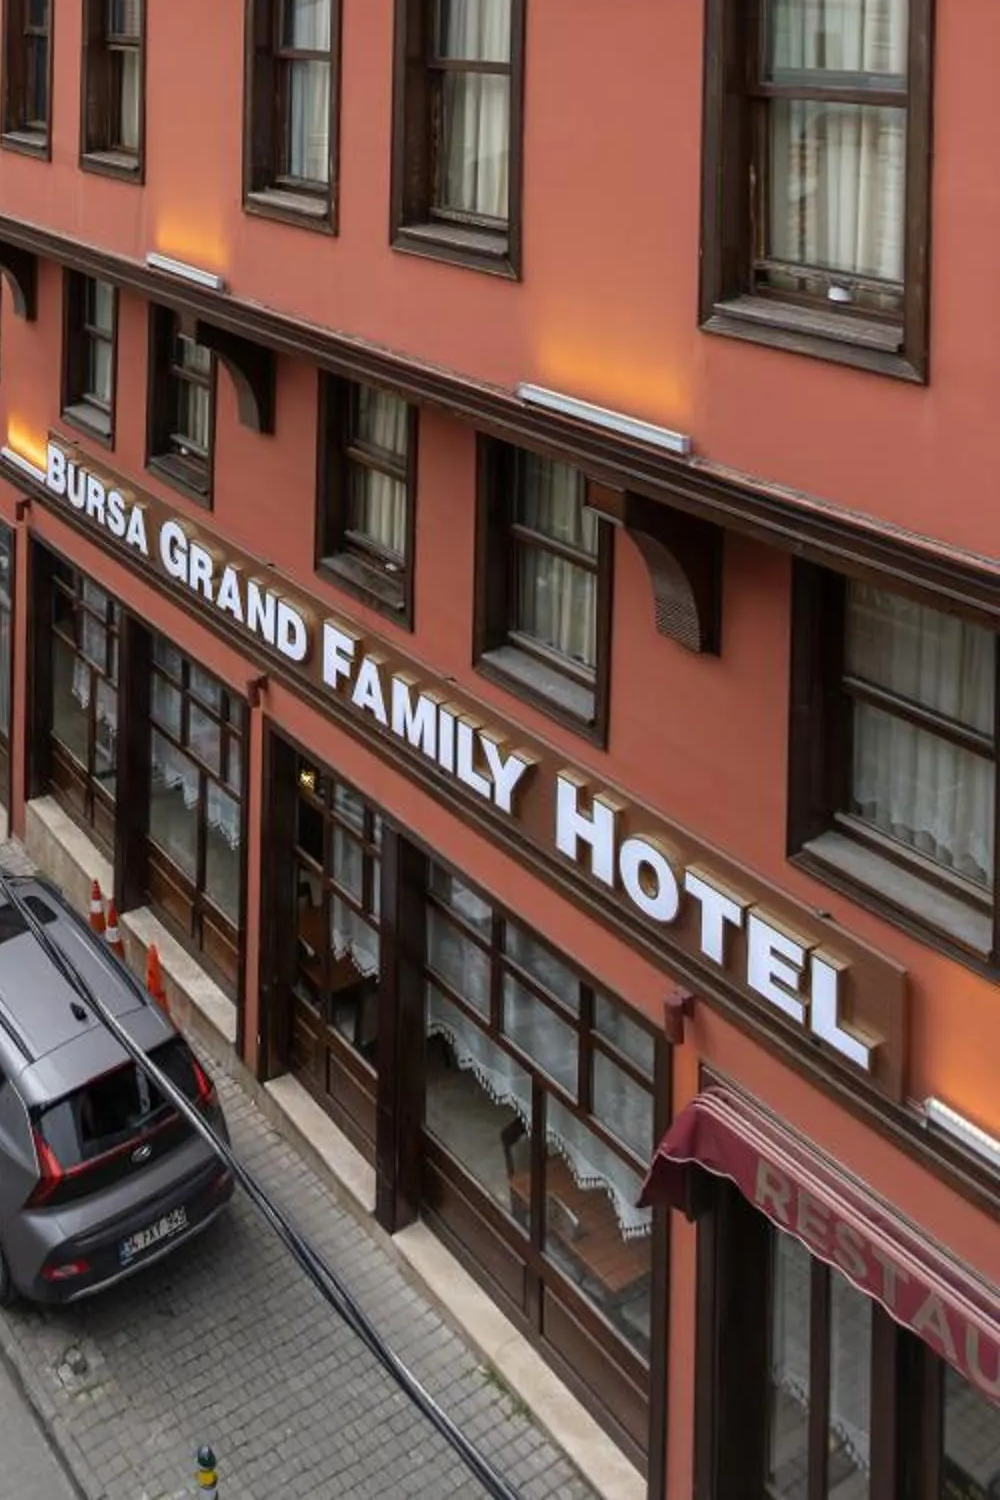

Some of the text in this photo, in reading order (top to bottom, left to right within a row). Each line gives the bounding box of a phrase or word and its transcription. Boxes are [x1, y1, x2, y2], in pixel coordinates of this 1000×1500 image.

[46, 440, 148, 555] BURSA
[160, 520, 308, 662] GRAND
[323, 618, 528, 814] FAMILY
[555, 773, 871, 1072] HOTEL
[754, 1157, 1000, 1396] RESTAU
